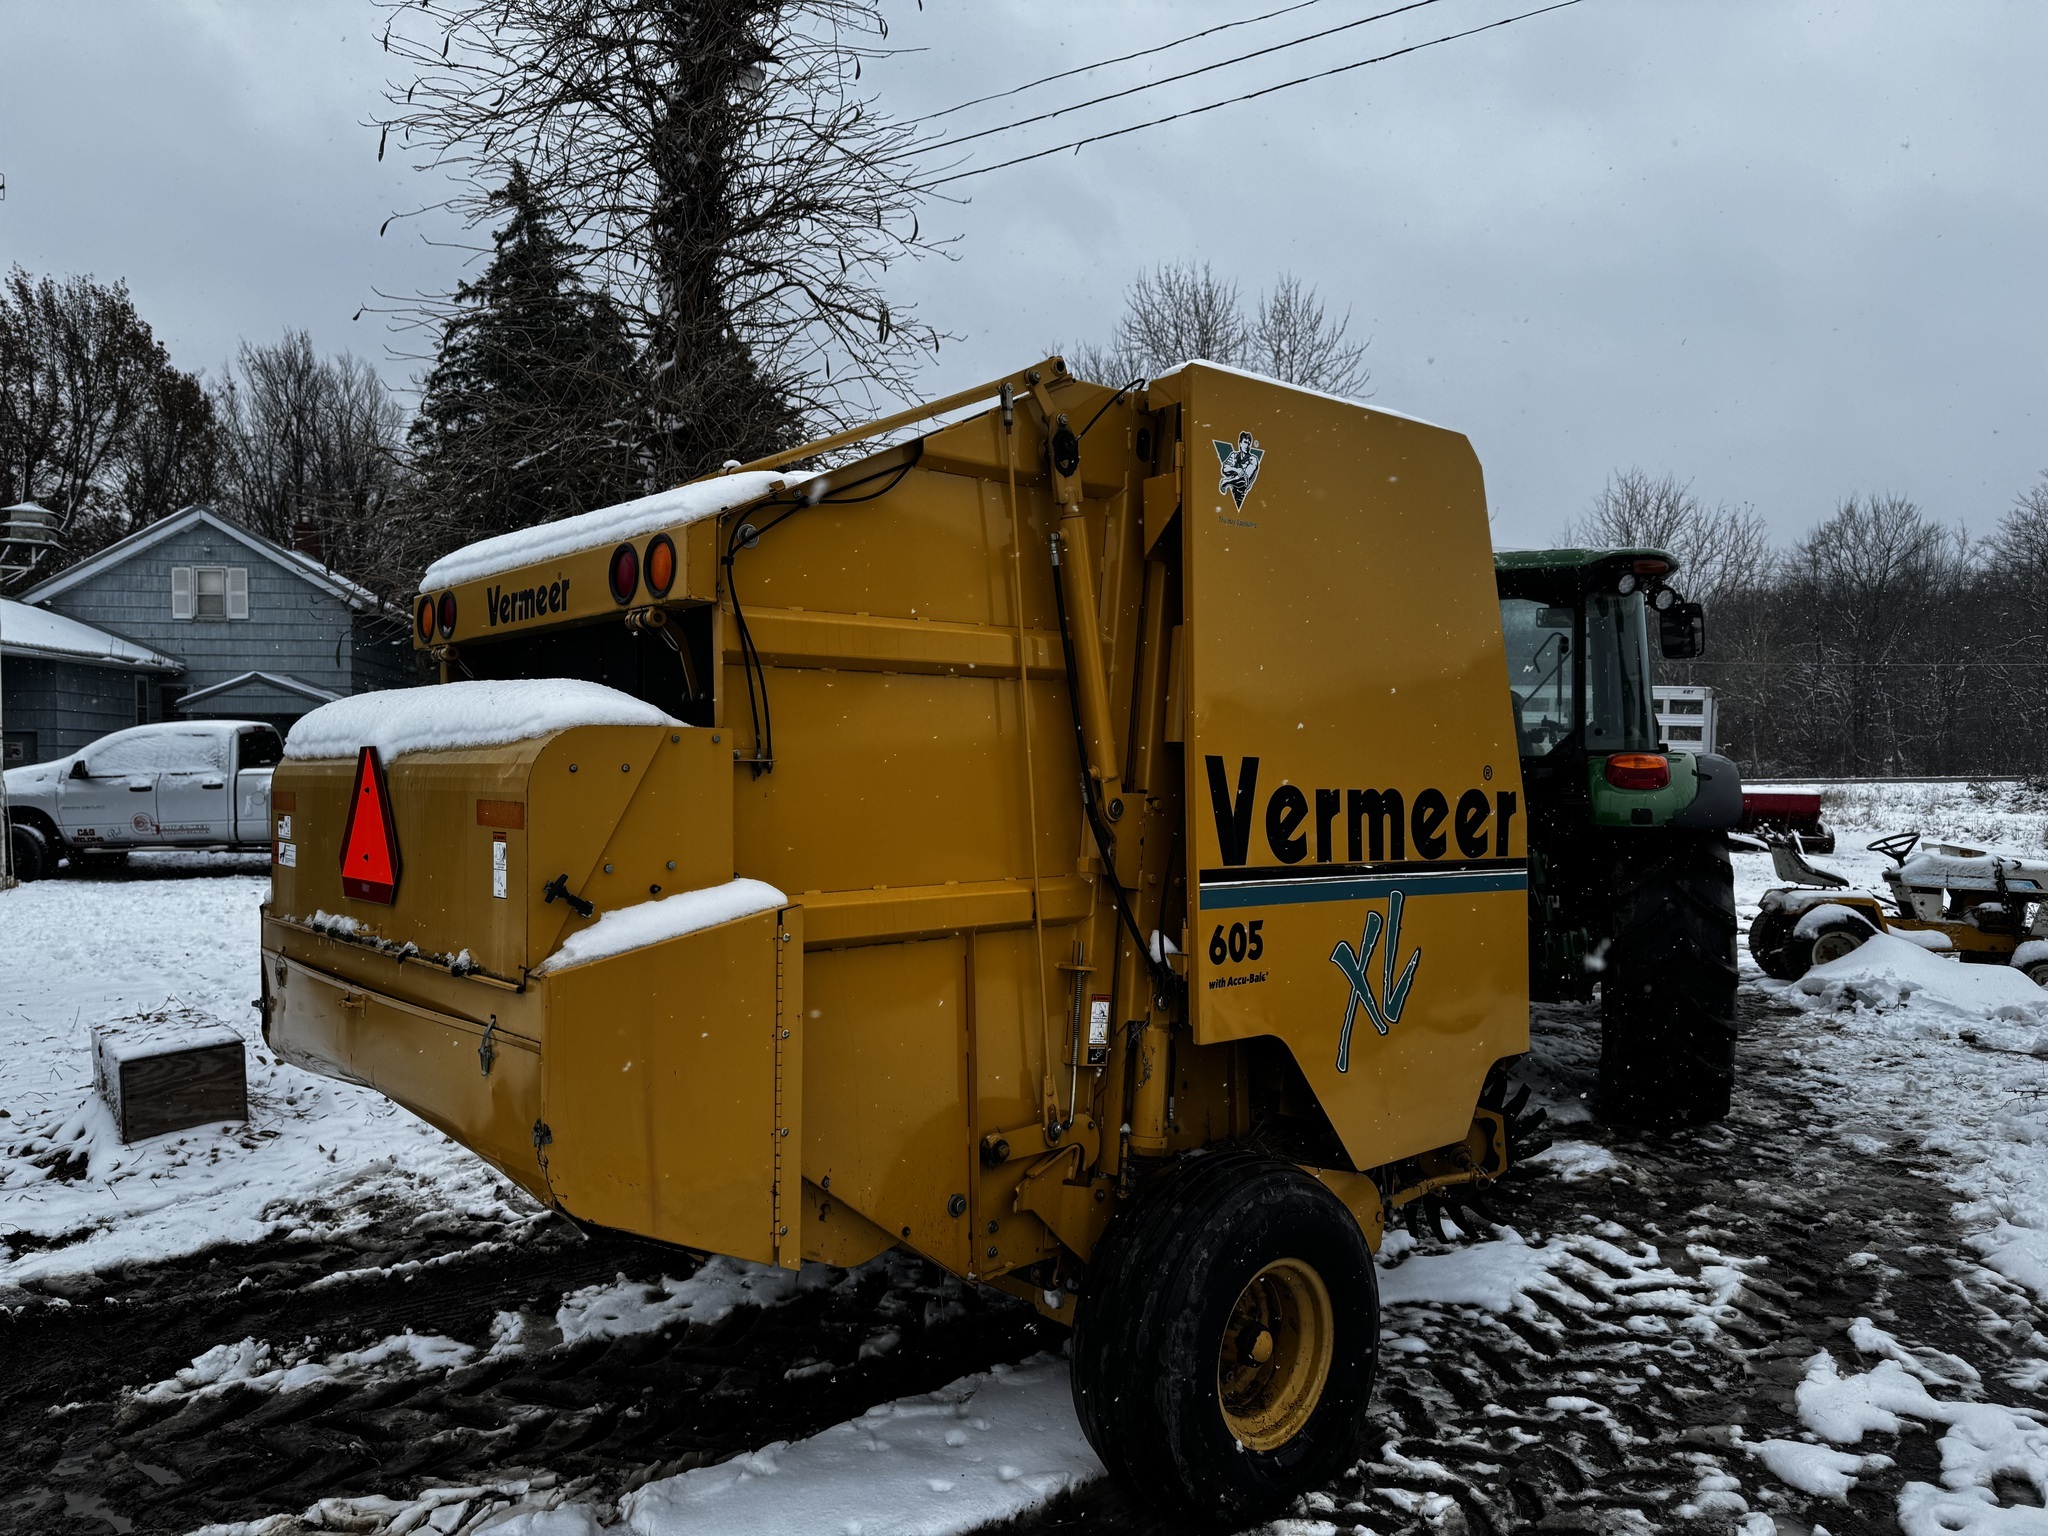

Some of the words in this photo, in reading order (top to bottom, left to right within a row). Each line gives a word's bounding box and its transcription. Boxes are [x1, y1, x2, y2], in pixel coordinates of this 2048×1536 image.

[487, 577, 570, 627] Vermeer
[1204, 754, 1517, 867] Vermeer
[1208, 918, 1265, 966] 605
[1208, 977, 1226, 990] with
[1329, 889, 1422, 1074] XL
